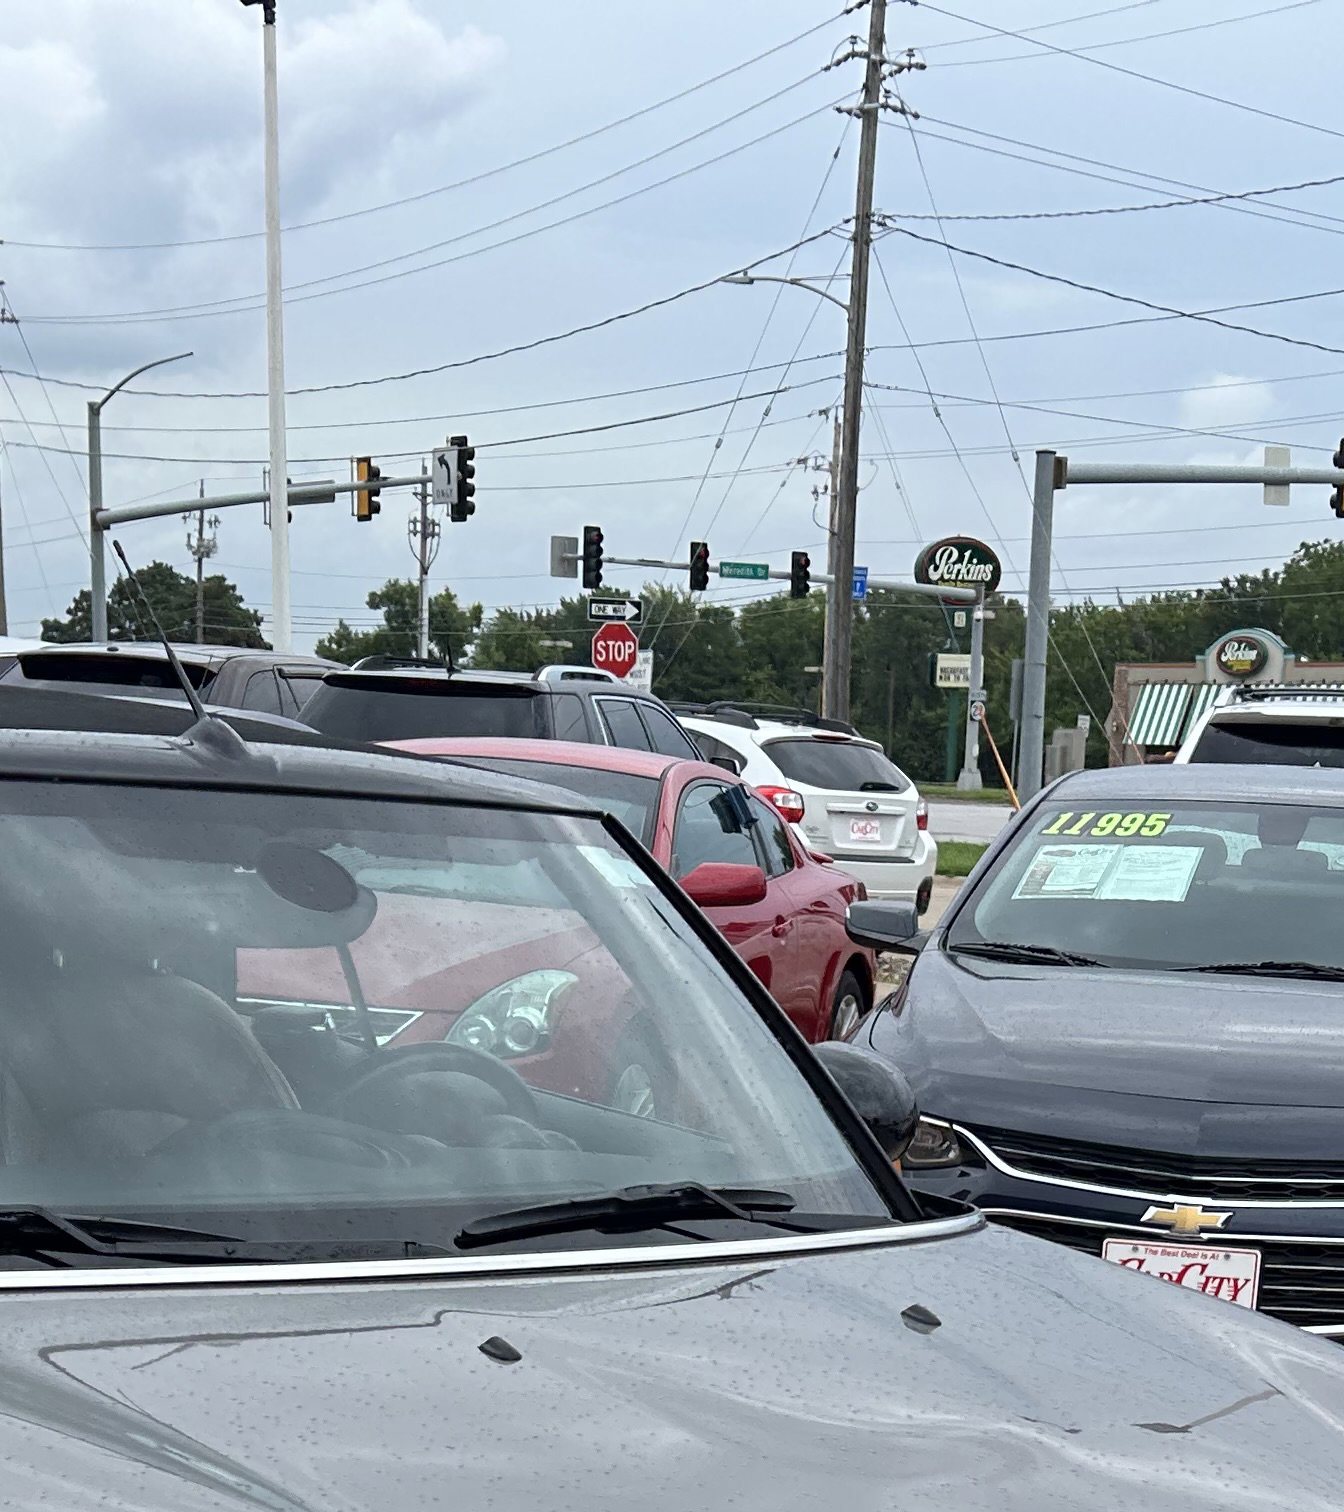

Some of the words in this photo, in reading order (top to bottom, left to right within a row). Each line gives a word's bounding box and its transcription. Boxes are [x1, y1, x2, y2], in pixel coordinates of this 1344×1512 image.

[927, 546, 994, 582] Perkins
[594, 604, 609, 615] ONE
[612, 604, 626, 615] WAY
[596, 640, 635, 662] STOP
[1040, 811, 1172, 837] 11995
[1144, 1247, 1158, 1257] The
[1161, 1248, 1179, 1258] Best
[1181, 1250, 1199, 1260] Deal
[1209, 1252, 1220, 1261] At
